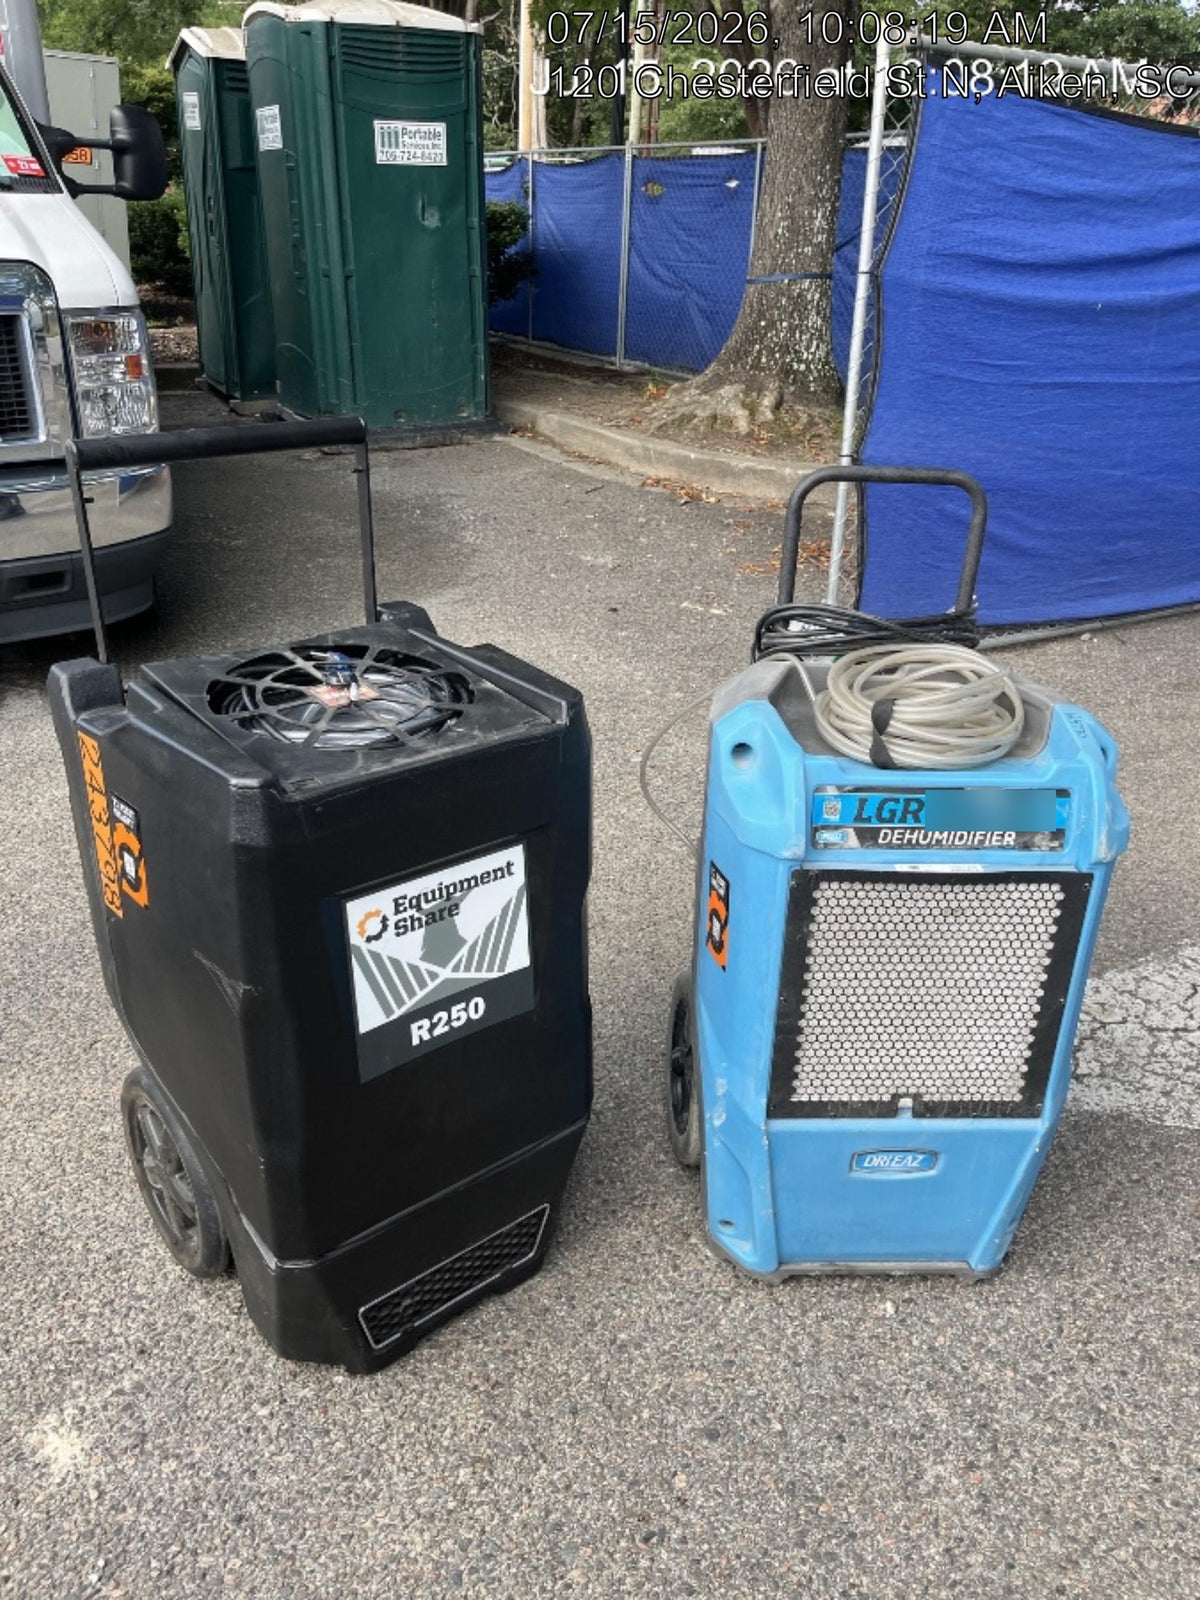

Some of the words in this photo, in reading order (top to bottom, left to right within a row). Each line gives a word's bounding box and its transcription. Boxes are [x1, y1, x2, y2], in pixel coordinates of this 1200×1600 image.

[853, 796, 925, 824] LGR
[877, 828, 1017, 847] DEHUMIDIFIER
[392, 859, 515, 917] Equipment
[393, 902, 460, 938] Share
[409, 996, 487, 1047] R250
